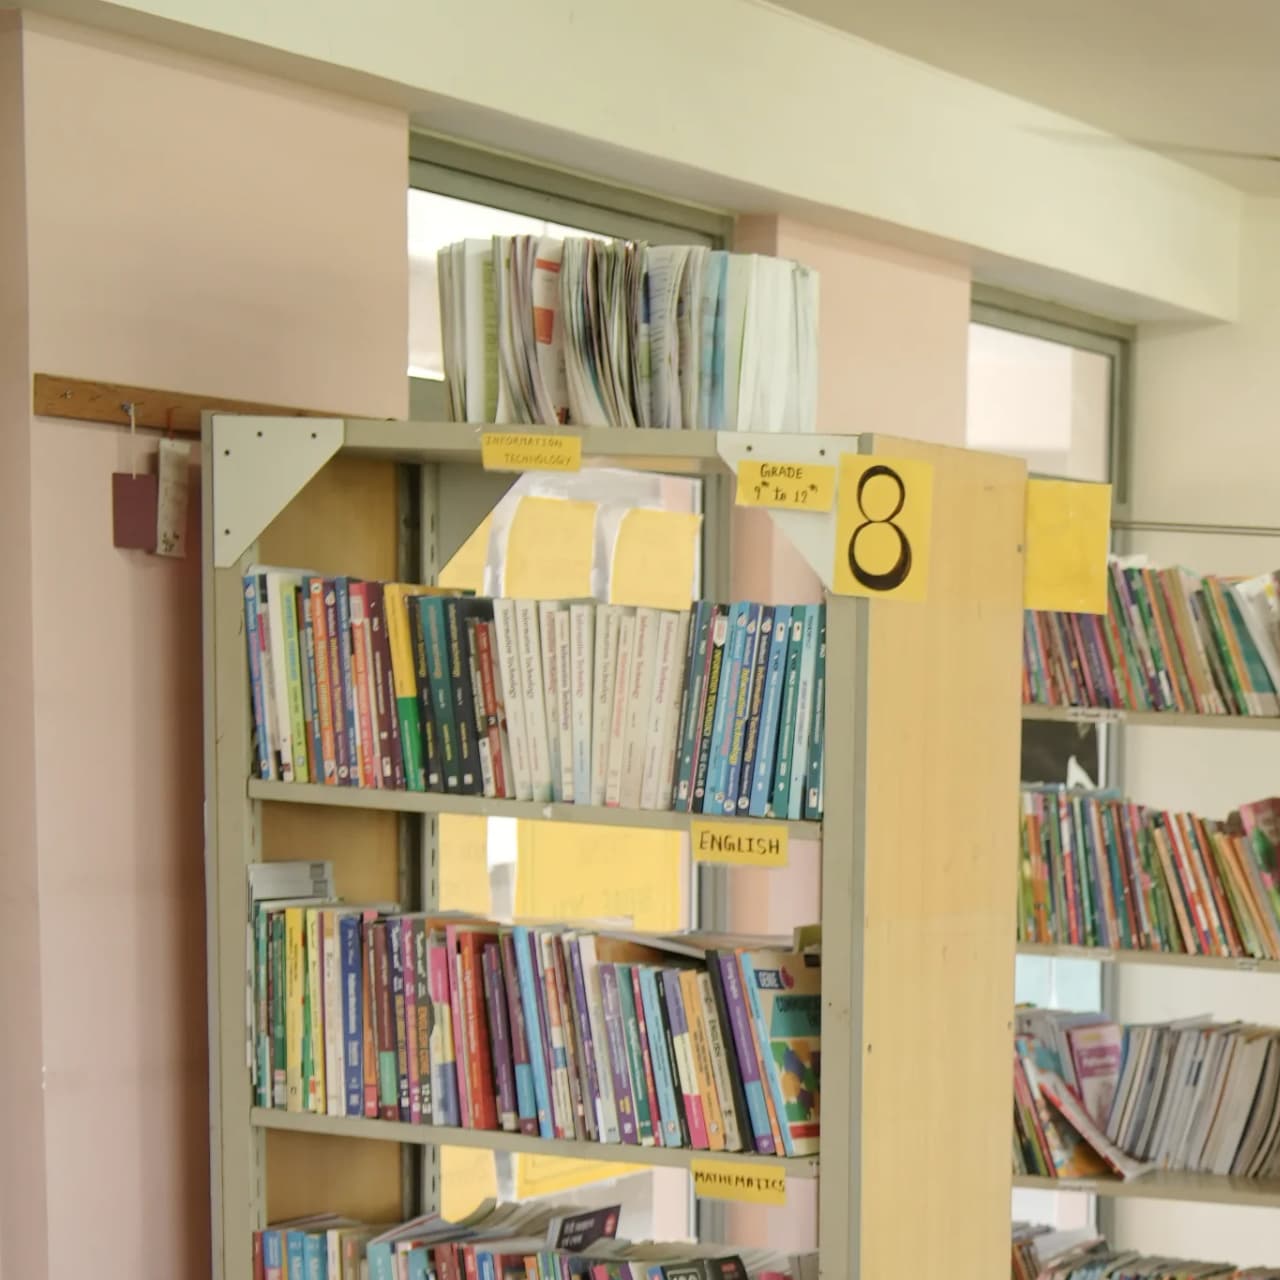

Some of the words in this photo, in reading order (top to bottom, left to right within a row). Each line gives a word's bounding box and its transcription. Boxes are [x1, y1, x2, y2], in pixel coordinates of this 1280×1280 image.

[760, 463, 803, 479] GRADE
[774, 487, 787, 501] to
[848, 465, 912, 591] 8
[699, 830, 780, 856] ENGLISH
[694, 1171, 785, 1192] MATHEMATICS
